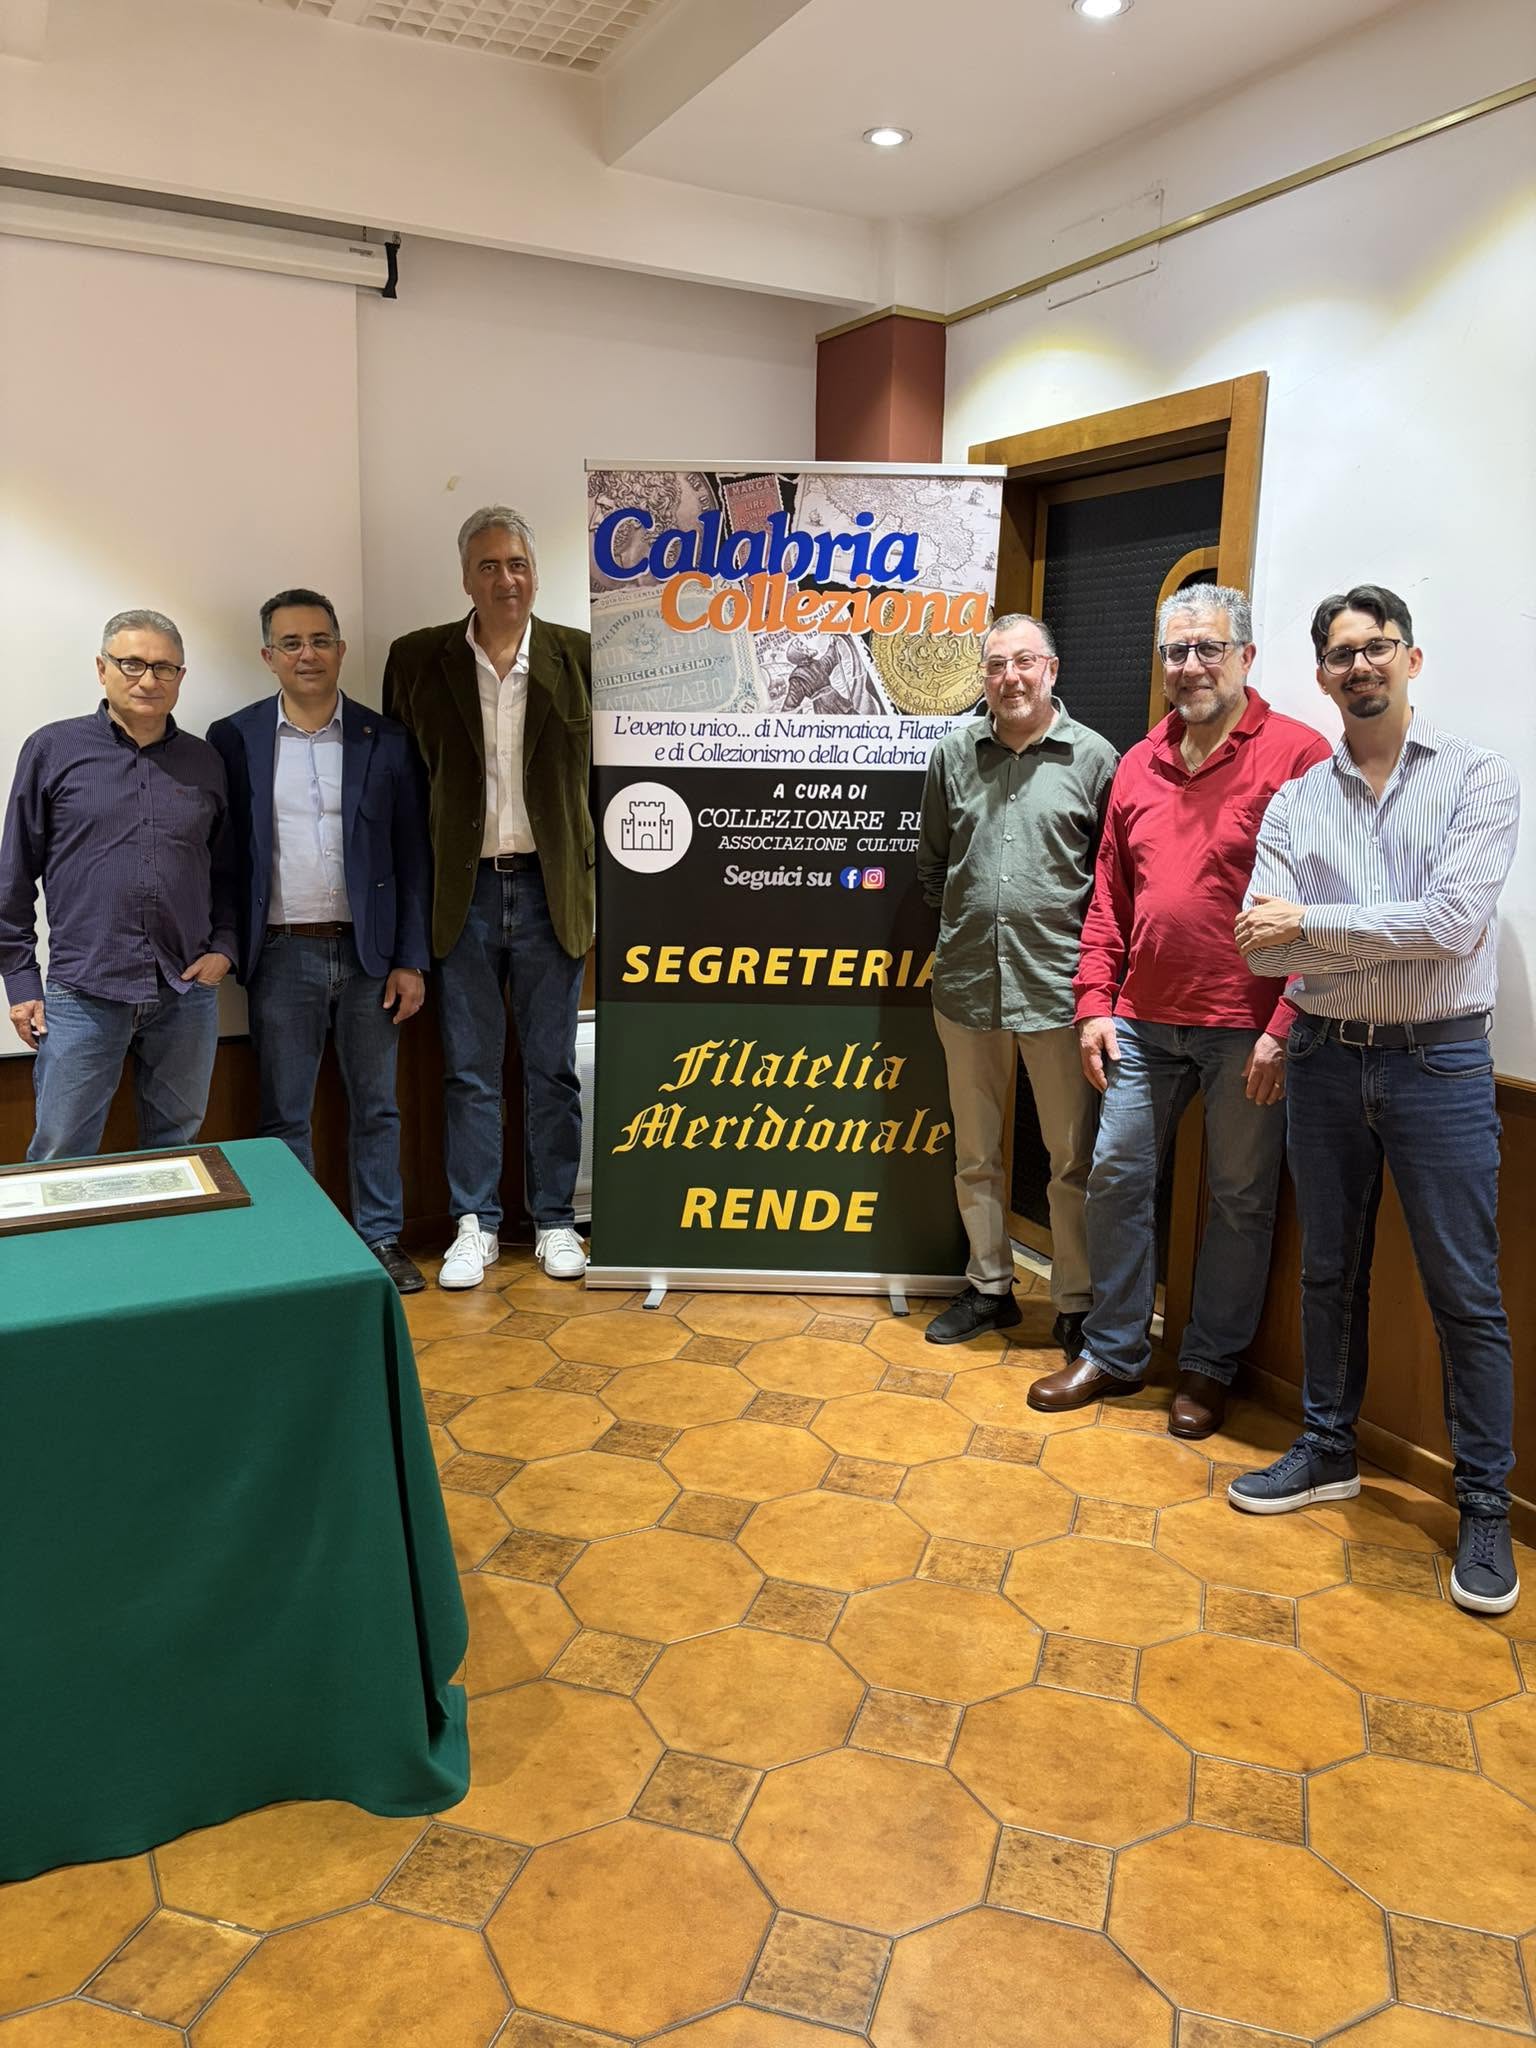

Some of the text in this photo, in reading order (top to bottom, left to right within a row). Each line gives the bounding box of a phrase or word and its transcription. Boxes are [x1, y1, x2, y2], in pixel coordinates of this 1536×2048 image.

[731, 480, 771, 496] MARCA
[744, 498, 767, 511] LIRE
[593, 507, 920, 583] Calabria
[660, 572, 991, 636] Colleziona
[593, 659, 712, 688] QUINDICI CENTESIMI
[614, 716, 960, 741] L'evento unico... di Numismatica, Filateli
[654, 742, 926, 765] e di Collezionismo della Calabria
[773, 783, 867, 800] A CURA DI
[697, 808, 885, 831] COLLEZIONARE
[718, 835, 848, 852] ASSOCIAZIONE
[723, 864, 803, 891] Seguici
[806, 871, 832, 888] su
[622, 945, 937, 988] SEGRETERIA
[658, 1039, 907, 1092] Filatelia
[611, 1102, 953, 1155] Meridionale
[680, 1187, 879, 1233] RENDE
